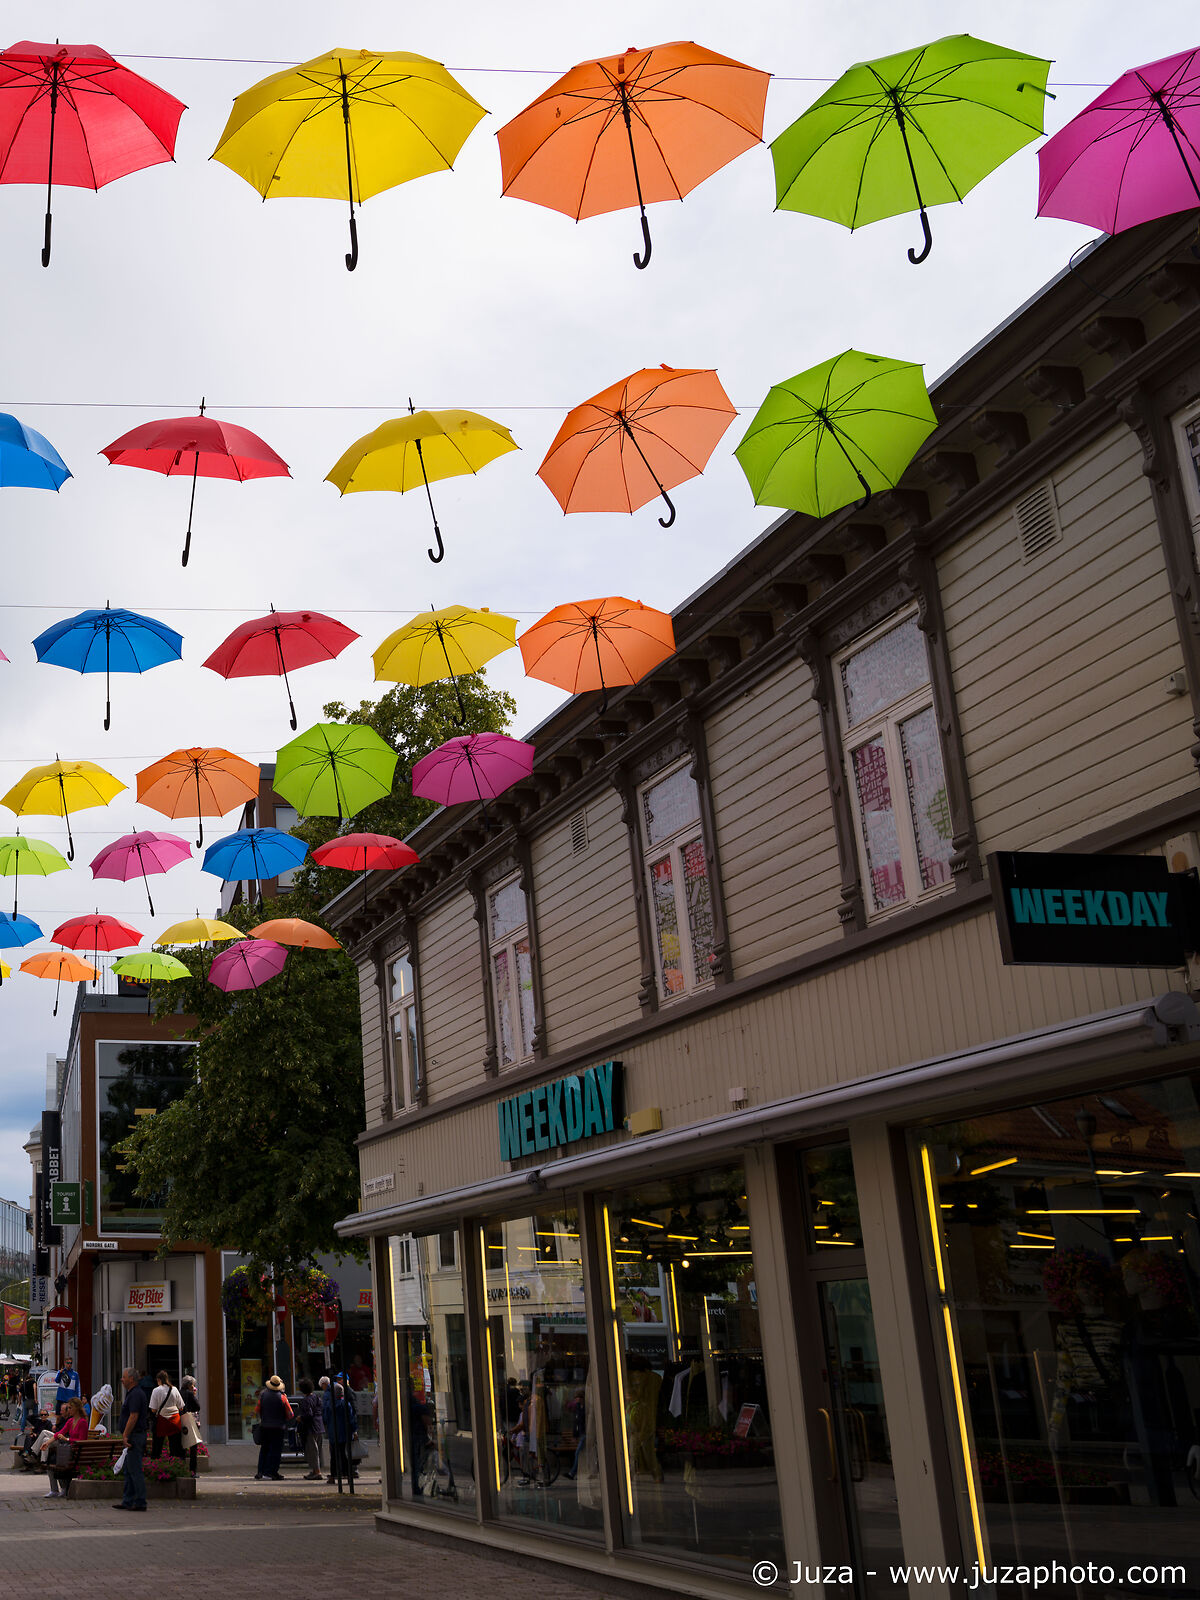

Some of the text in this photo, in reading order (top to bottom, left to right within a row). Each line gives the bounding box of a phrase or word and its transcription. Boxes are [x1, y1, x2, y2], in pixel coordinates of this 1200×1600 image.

[1010, 888, 1168, 927] WEEKDAY
[497, 1061, 614, 1162] WEEKDAY
[128, 1288, 164, 1309] Big Bite
